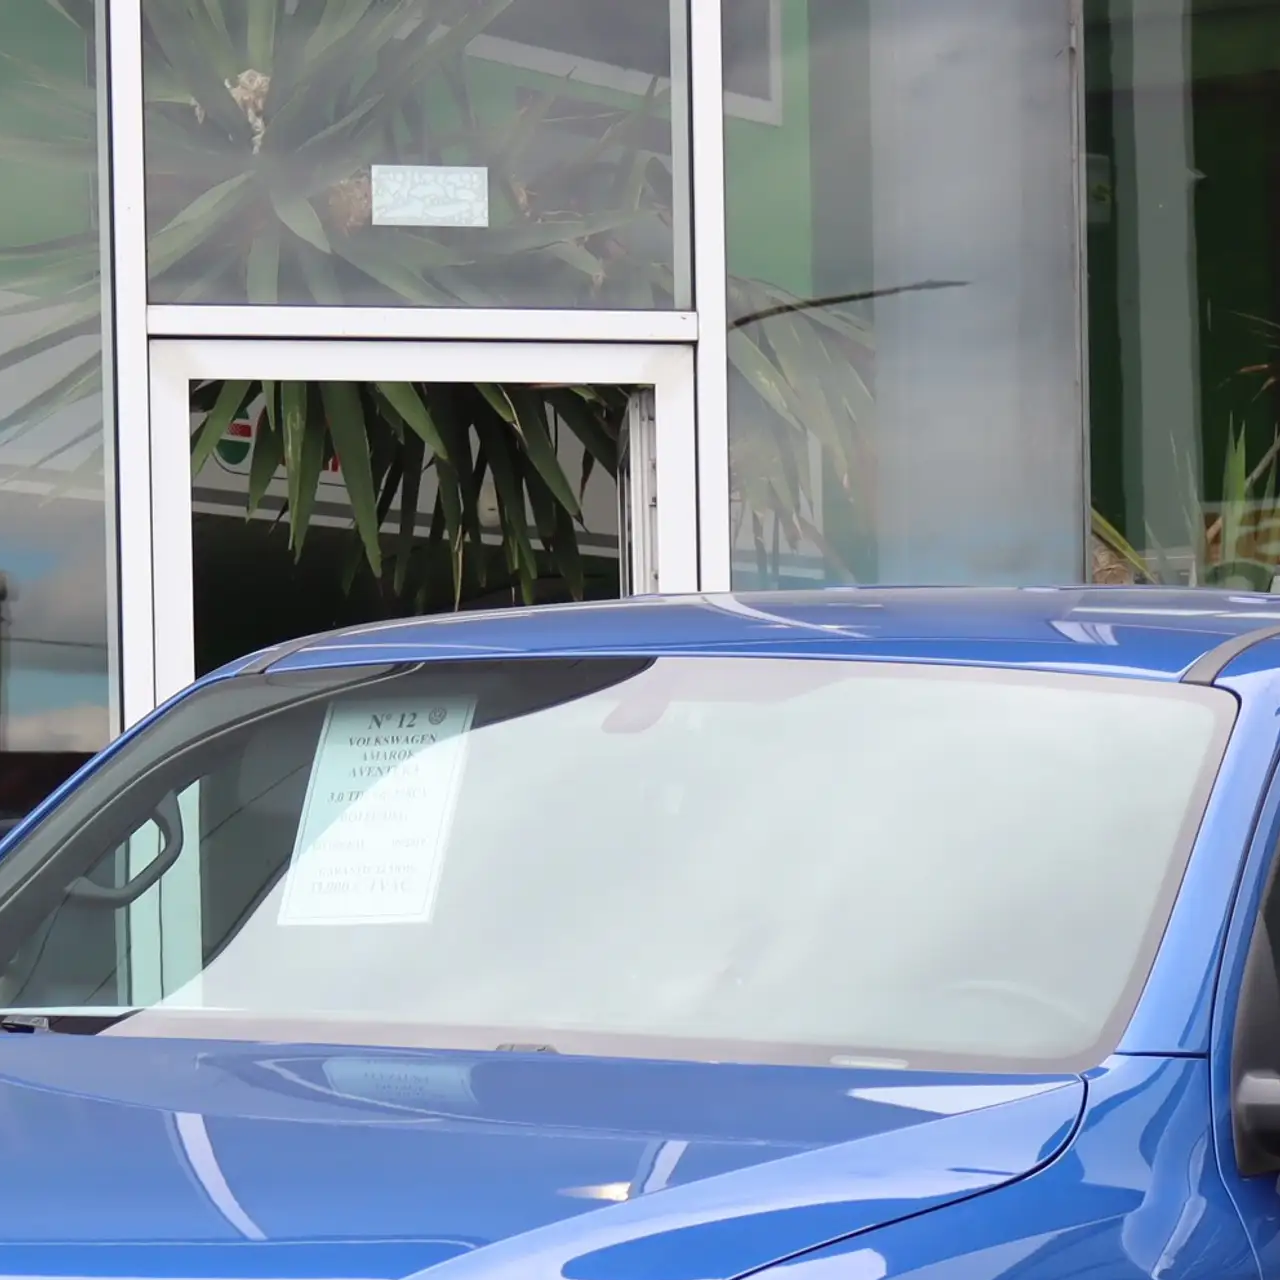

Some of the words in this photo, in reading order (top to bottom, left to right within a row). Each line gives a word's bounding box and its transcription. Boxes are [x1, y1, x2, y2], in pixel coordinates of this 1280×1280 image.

[397, 711, 418, 728] 12
[348, 733, 438, 748] VOLKSWAGEN
[348, 763, 420, 779] AVENTRA
